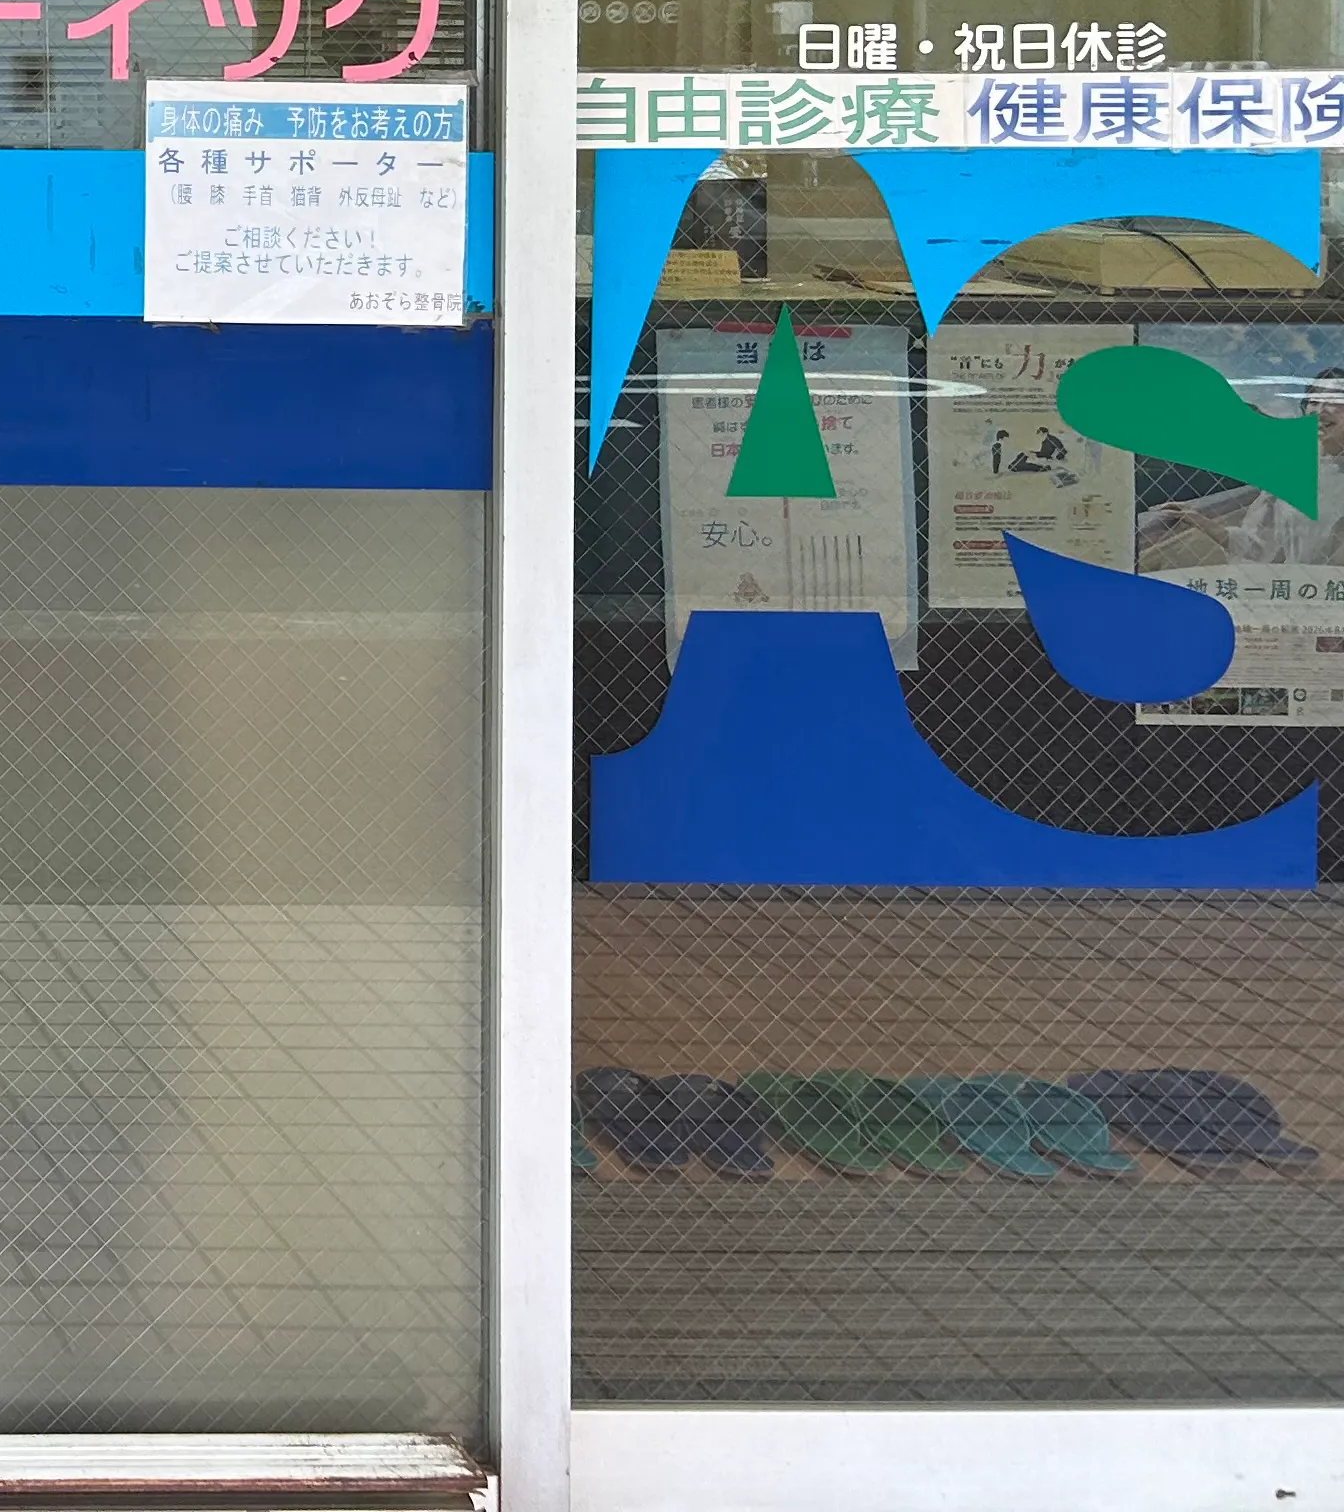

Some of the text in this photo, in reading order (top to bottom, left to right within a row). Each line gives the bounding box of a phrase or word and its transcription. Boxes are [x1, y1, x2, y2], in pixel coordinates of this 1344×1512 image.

[798, 22, 1167, 70] 日曜・祝日休診
[160, 104, 453, 139] 身体の痛み 予防をお考えの方
[577, 76, 940, 145] 自由診療
[159, 148, 444, 176] 各種サポーター
[210, 184, 226, 206] 膝
[242, 184, 274, 207] 手首
[290, 185, 322, 207] 猫背
[339, 186, 403, 208] 外反母趾
[224, 226, 377, 250] ご相談ください!
[175, 250, 422, 279] ご提案させていただきます。
[349, 291, 462, 313] あおぞら整骨院
[736, 341, 826, 364] 当は
[700, 521, 773, 548] 安心。
